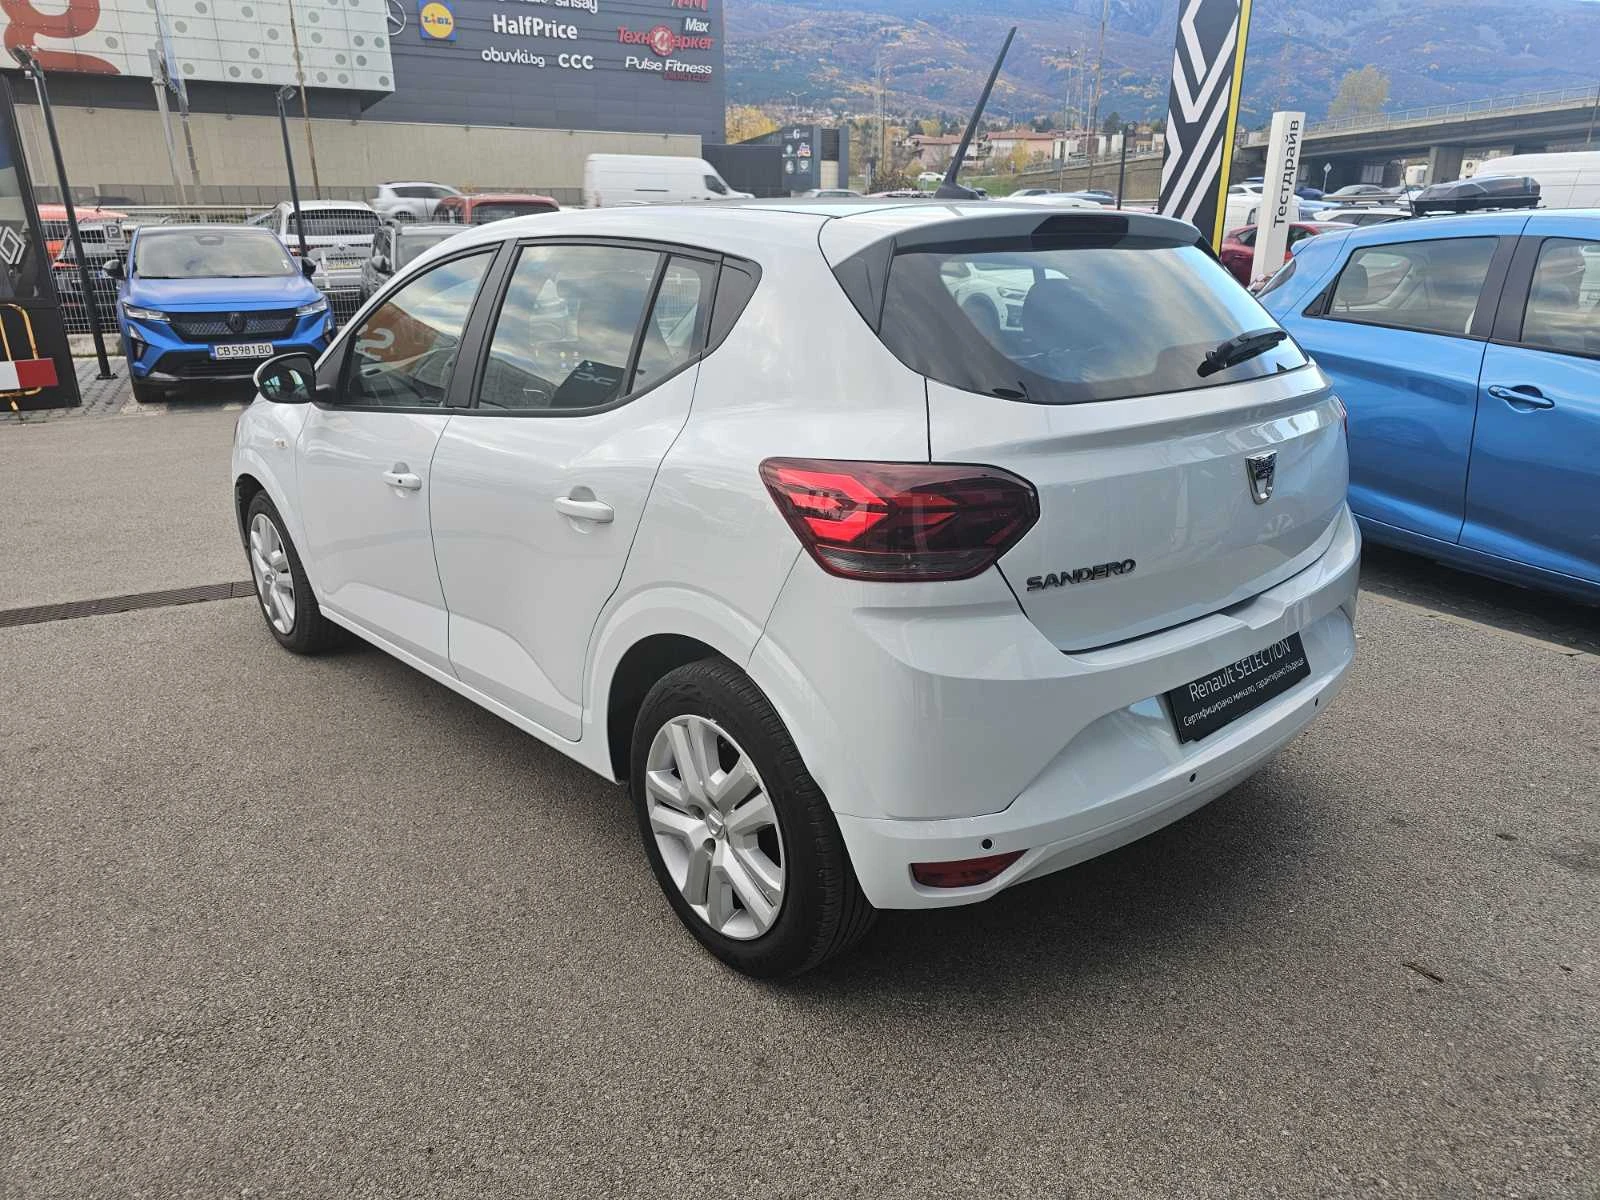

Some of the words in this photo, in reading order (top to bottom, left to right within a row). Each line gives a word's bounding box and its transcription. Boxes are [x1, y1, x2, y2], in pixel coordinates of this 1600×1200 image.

[493, 14, 578, 39] HalfPrice
[685, 17, 709, 32] Max
[481, 47, 545, 67] obuvki.bg
[558, 53, 594, 70] CCC
[625, 56, 662, 71] Pulse
[664, 59, 712, 74] Fitness
[1274, 120, 1299, 228] Тестдрайв
[1026, 558, 1137, 592] SANDERO
[1189, 666, 1236, 702] Renault
[1235, 639, 1291, 680] SELECTION
